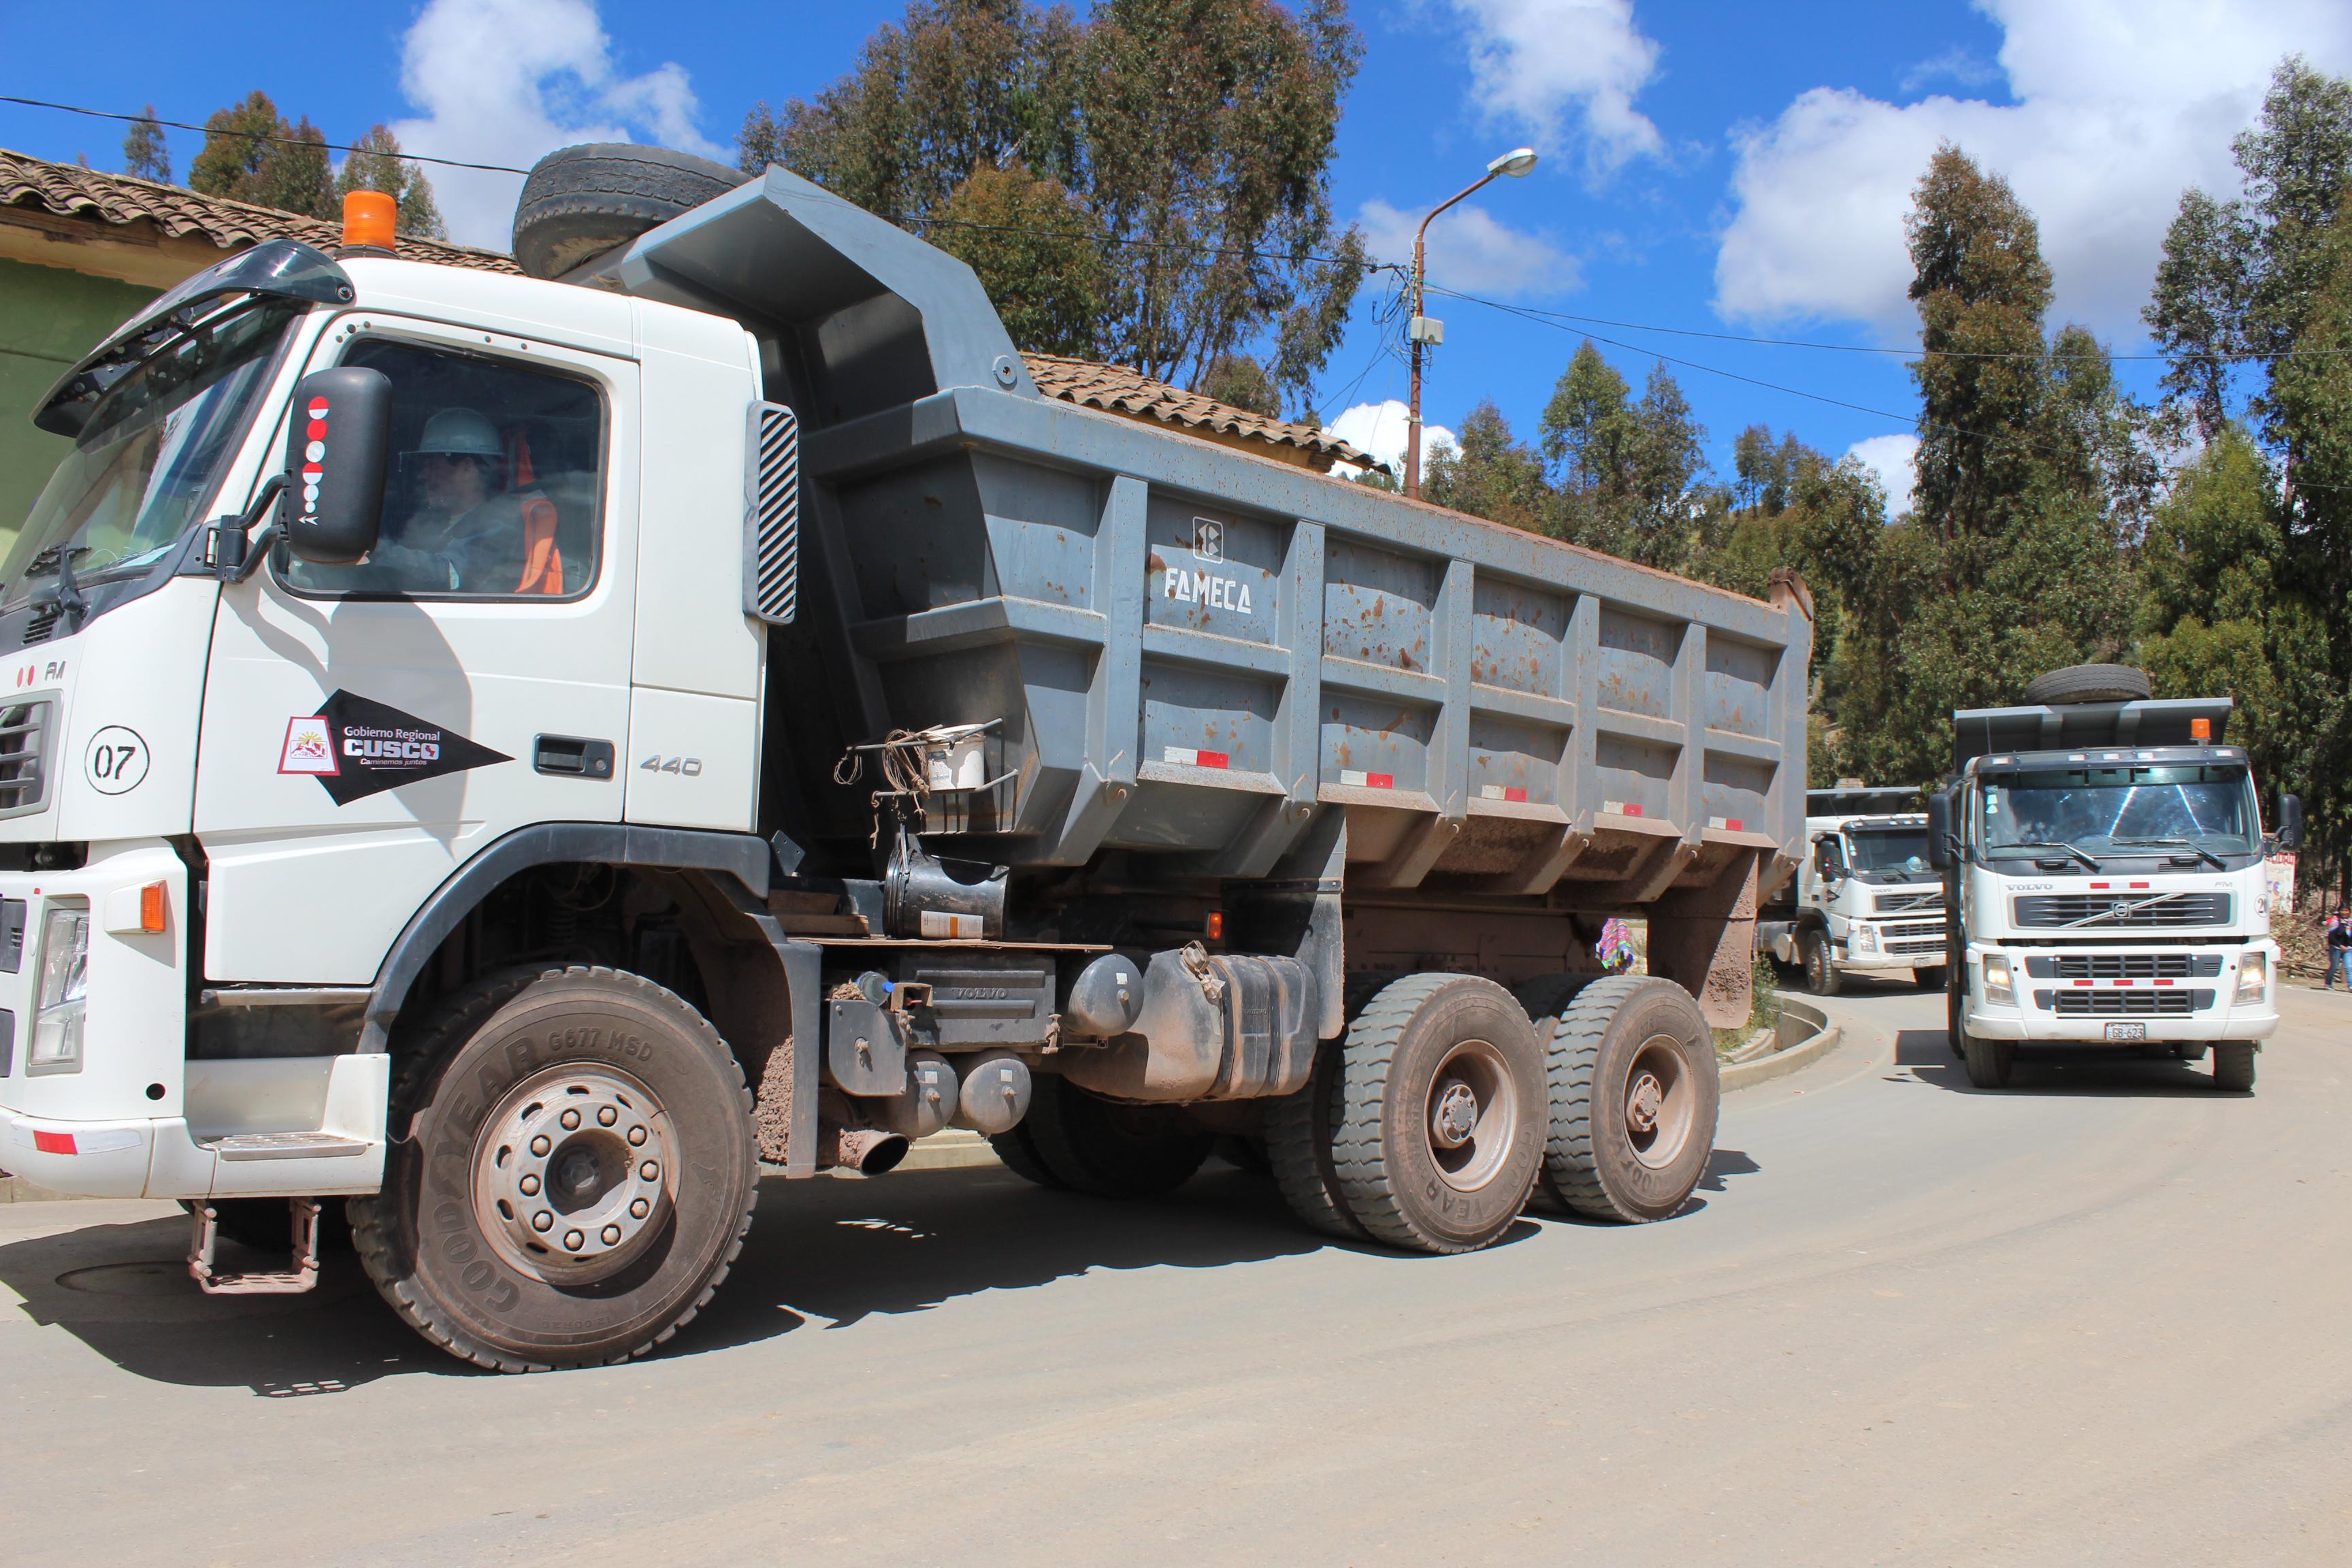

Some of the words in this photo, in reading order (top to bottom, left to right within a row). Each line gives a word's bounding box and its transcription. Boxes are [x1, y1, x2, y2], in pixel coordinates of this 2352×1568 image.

[1164, 568, 1252, 615] FAMECA
[344, 726, 393, 738] Gobierno
[395, 729, 440, 742] Regional
[344, 739, 440, 760] CUSCO
[95, 745, 136, 780] 07
[640, 754, 702, 777] 440
[951, 987, 1008, 1000] VOLVO
[432, 1036, 538, 1312] GOODYEAR
[548, 1026, 601, 1051] G677
[607, 1030, 653, 1062] MSD
